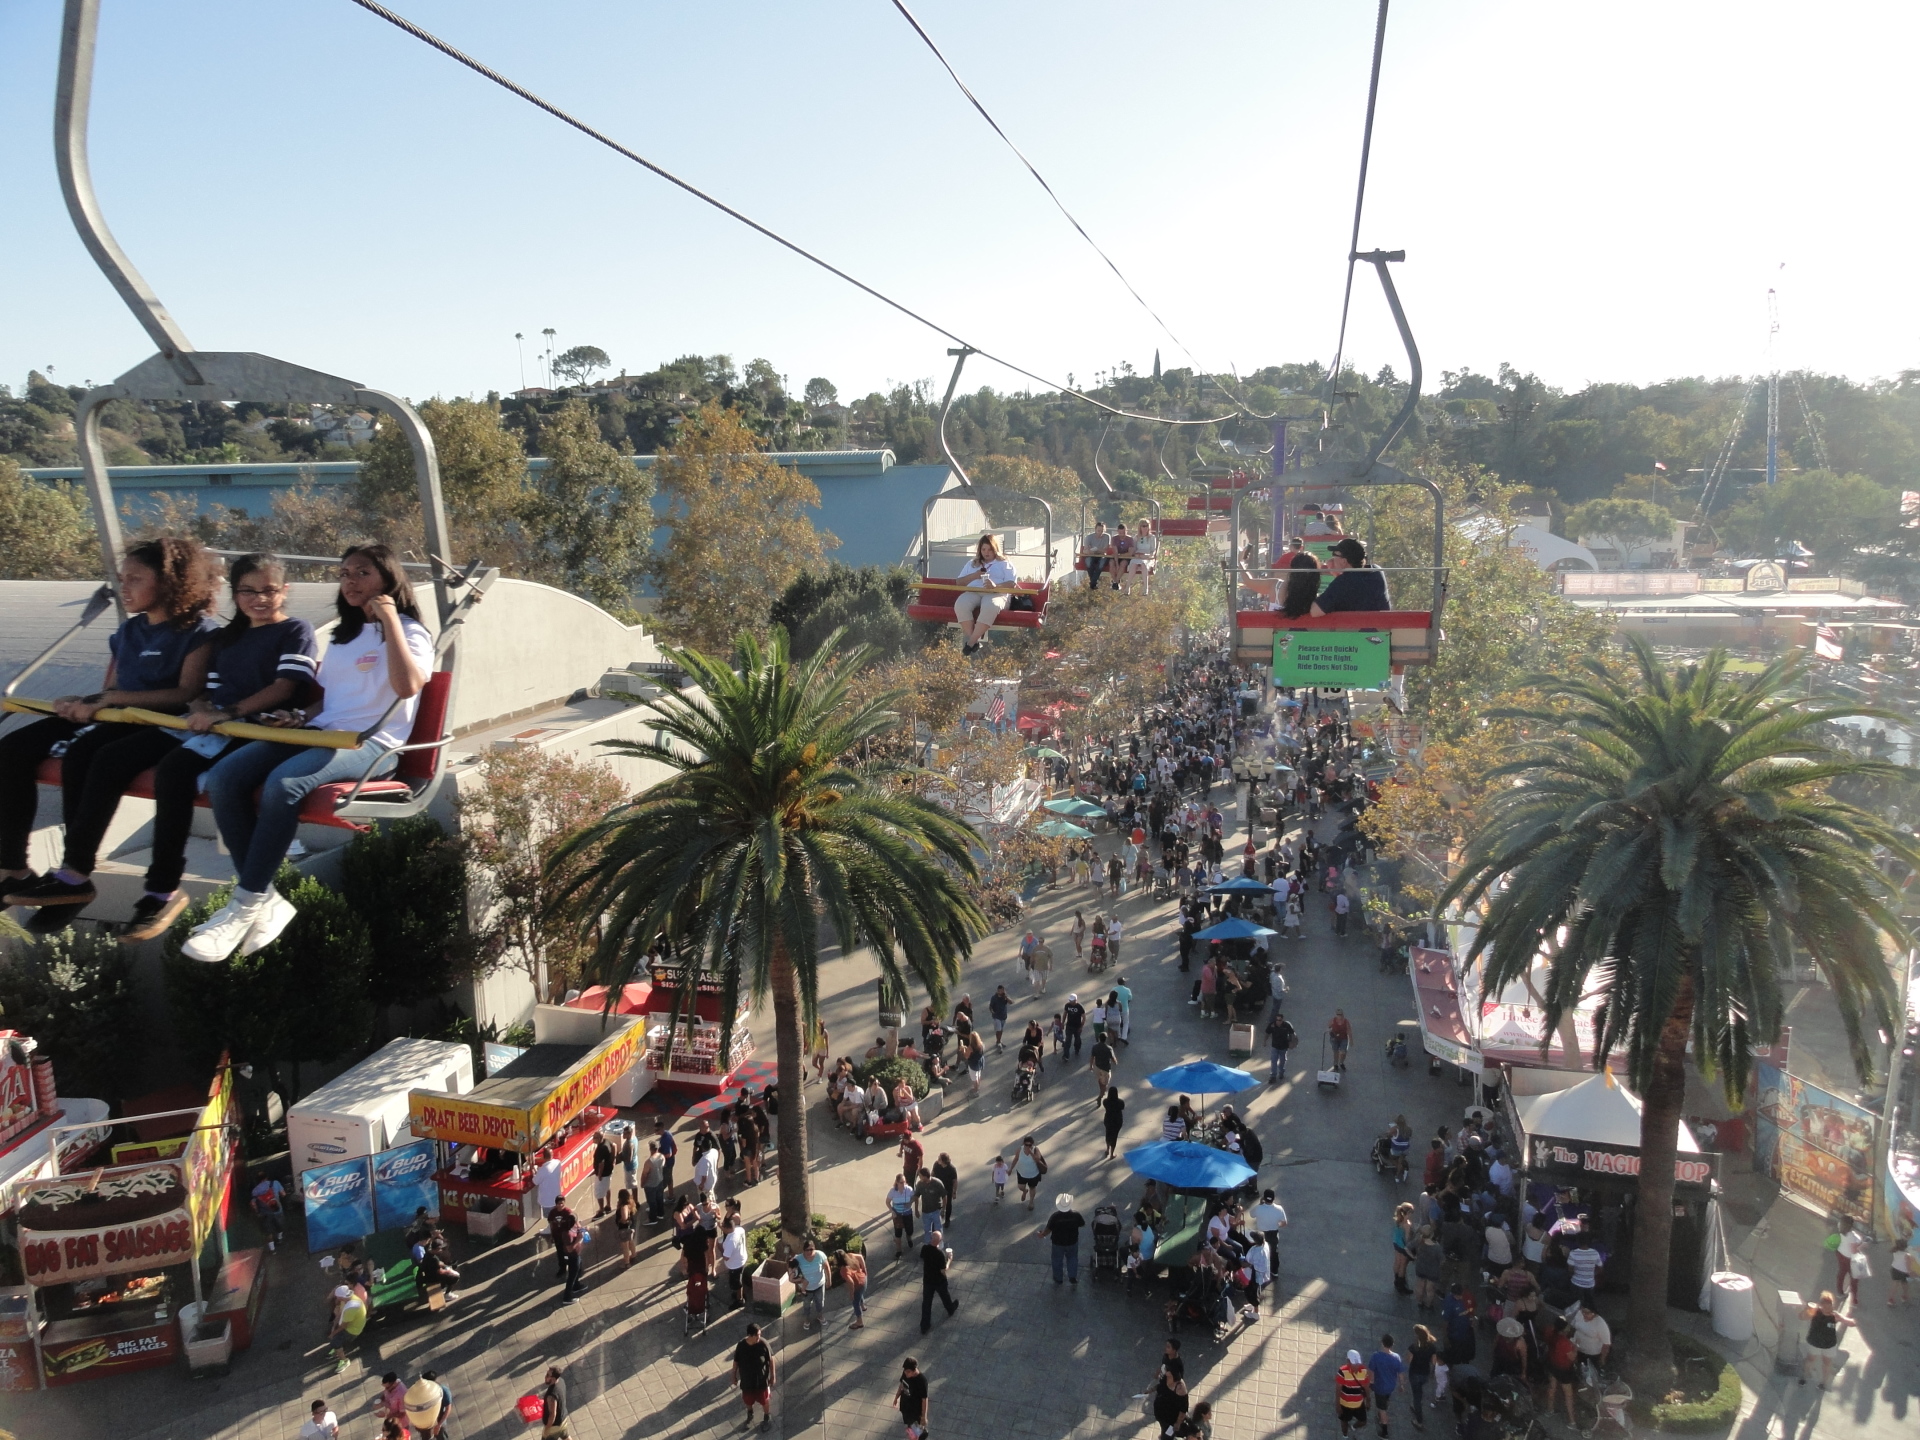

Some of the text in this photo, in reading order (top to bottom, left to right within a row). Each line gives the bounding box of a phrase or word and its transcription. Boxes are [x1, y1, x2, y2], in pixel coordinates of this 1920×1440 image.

[1321, 645, 1333, 653] Exit
[1313, 663, 1330, 671] Does
[549, 1038, 632, 1127] DRAFT BEER DEPOT
[423, 1106, 516, 1141] DRAFT BEER DEPOT
[391, 1153, 427, 1170] BUD
[1553, 1146, 1578, 1164] The
[384, 1159, 431, 1180] LIGHT
[560, 1157, 580, 1193] OLD
[315, 1177, 365, 1198] LIGHT
[323, 1172, 360, 1189] BUD
[1789, 1168, 1835, 1204] EXCITING
[442, 1189, 459, 1207] ICE
[24, 1219, 192, 1276] BIG FAT SAUSAGE
[109, 1340, 169, 1358] SAUSAGES
[117, 1335, 159, 1350] BIG FAT
